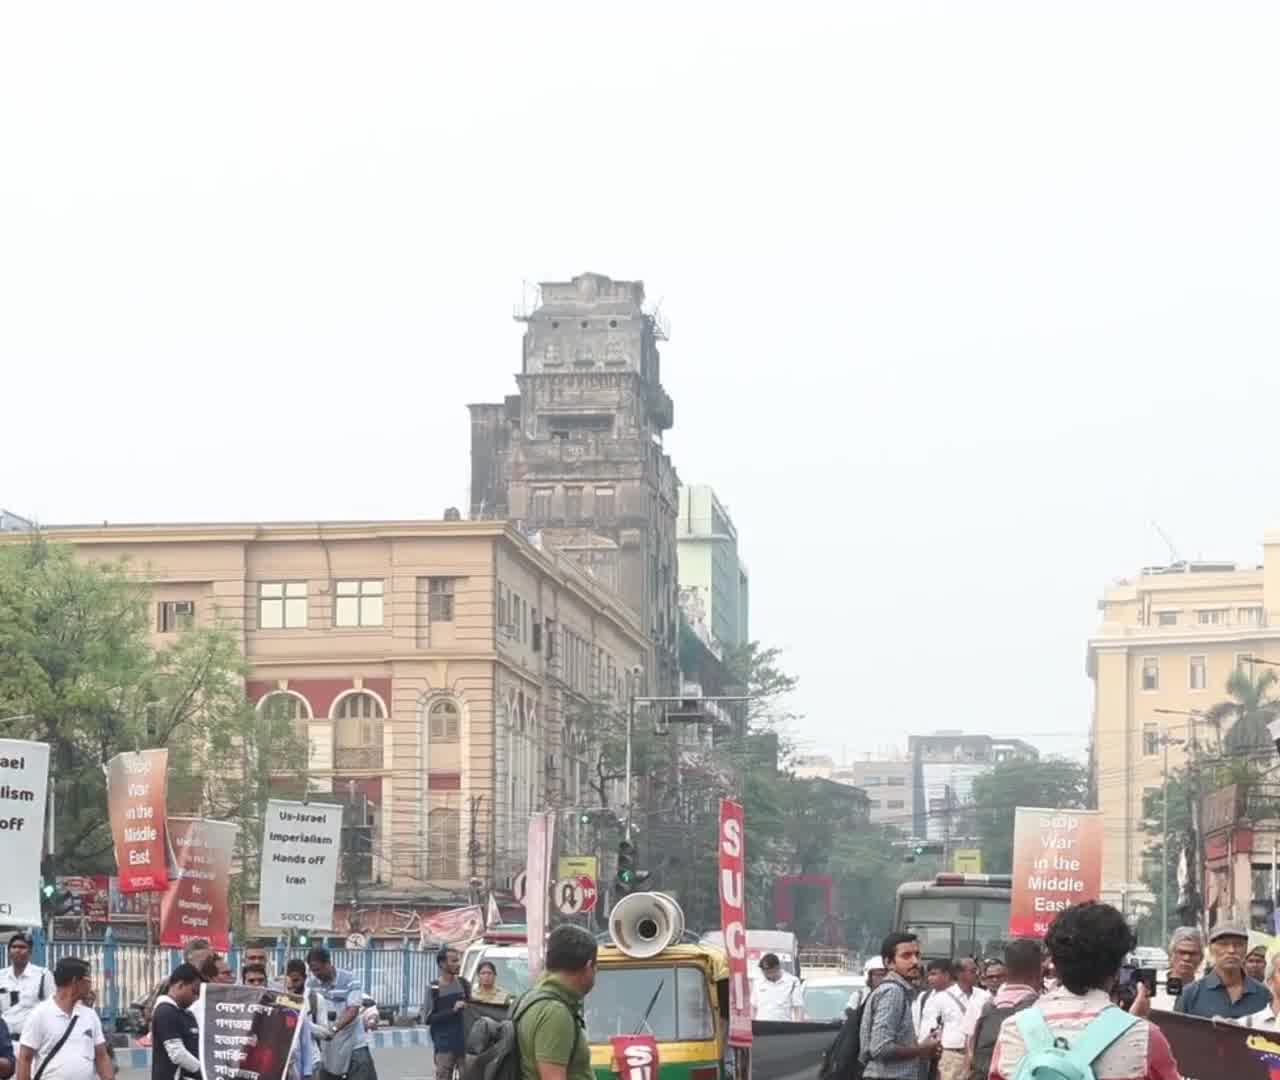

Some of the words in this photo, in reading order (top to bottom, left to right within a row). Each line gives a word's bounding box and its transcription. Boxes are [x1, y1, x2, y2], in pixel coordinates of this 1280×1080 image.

[279, 811, 327, 824] Us-Israel
[269, 832, 333, 845] Imperialism
[1041, 836, 1075, 849] War
[129, 849, 151, 865] East
[273, 853, 306, 864] Hands
[308, 855, 326, 865] off
[1033, 857, 1048, 869] in
[1054, 855, 1081, 871] the
[1028, 875, 1084, 892] Middle
[722, 817, 747, 1011] SUCI
